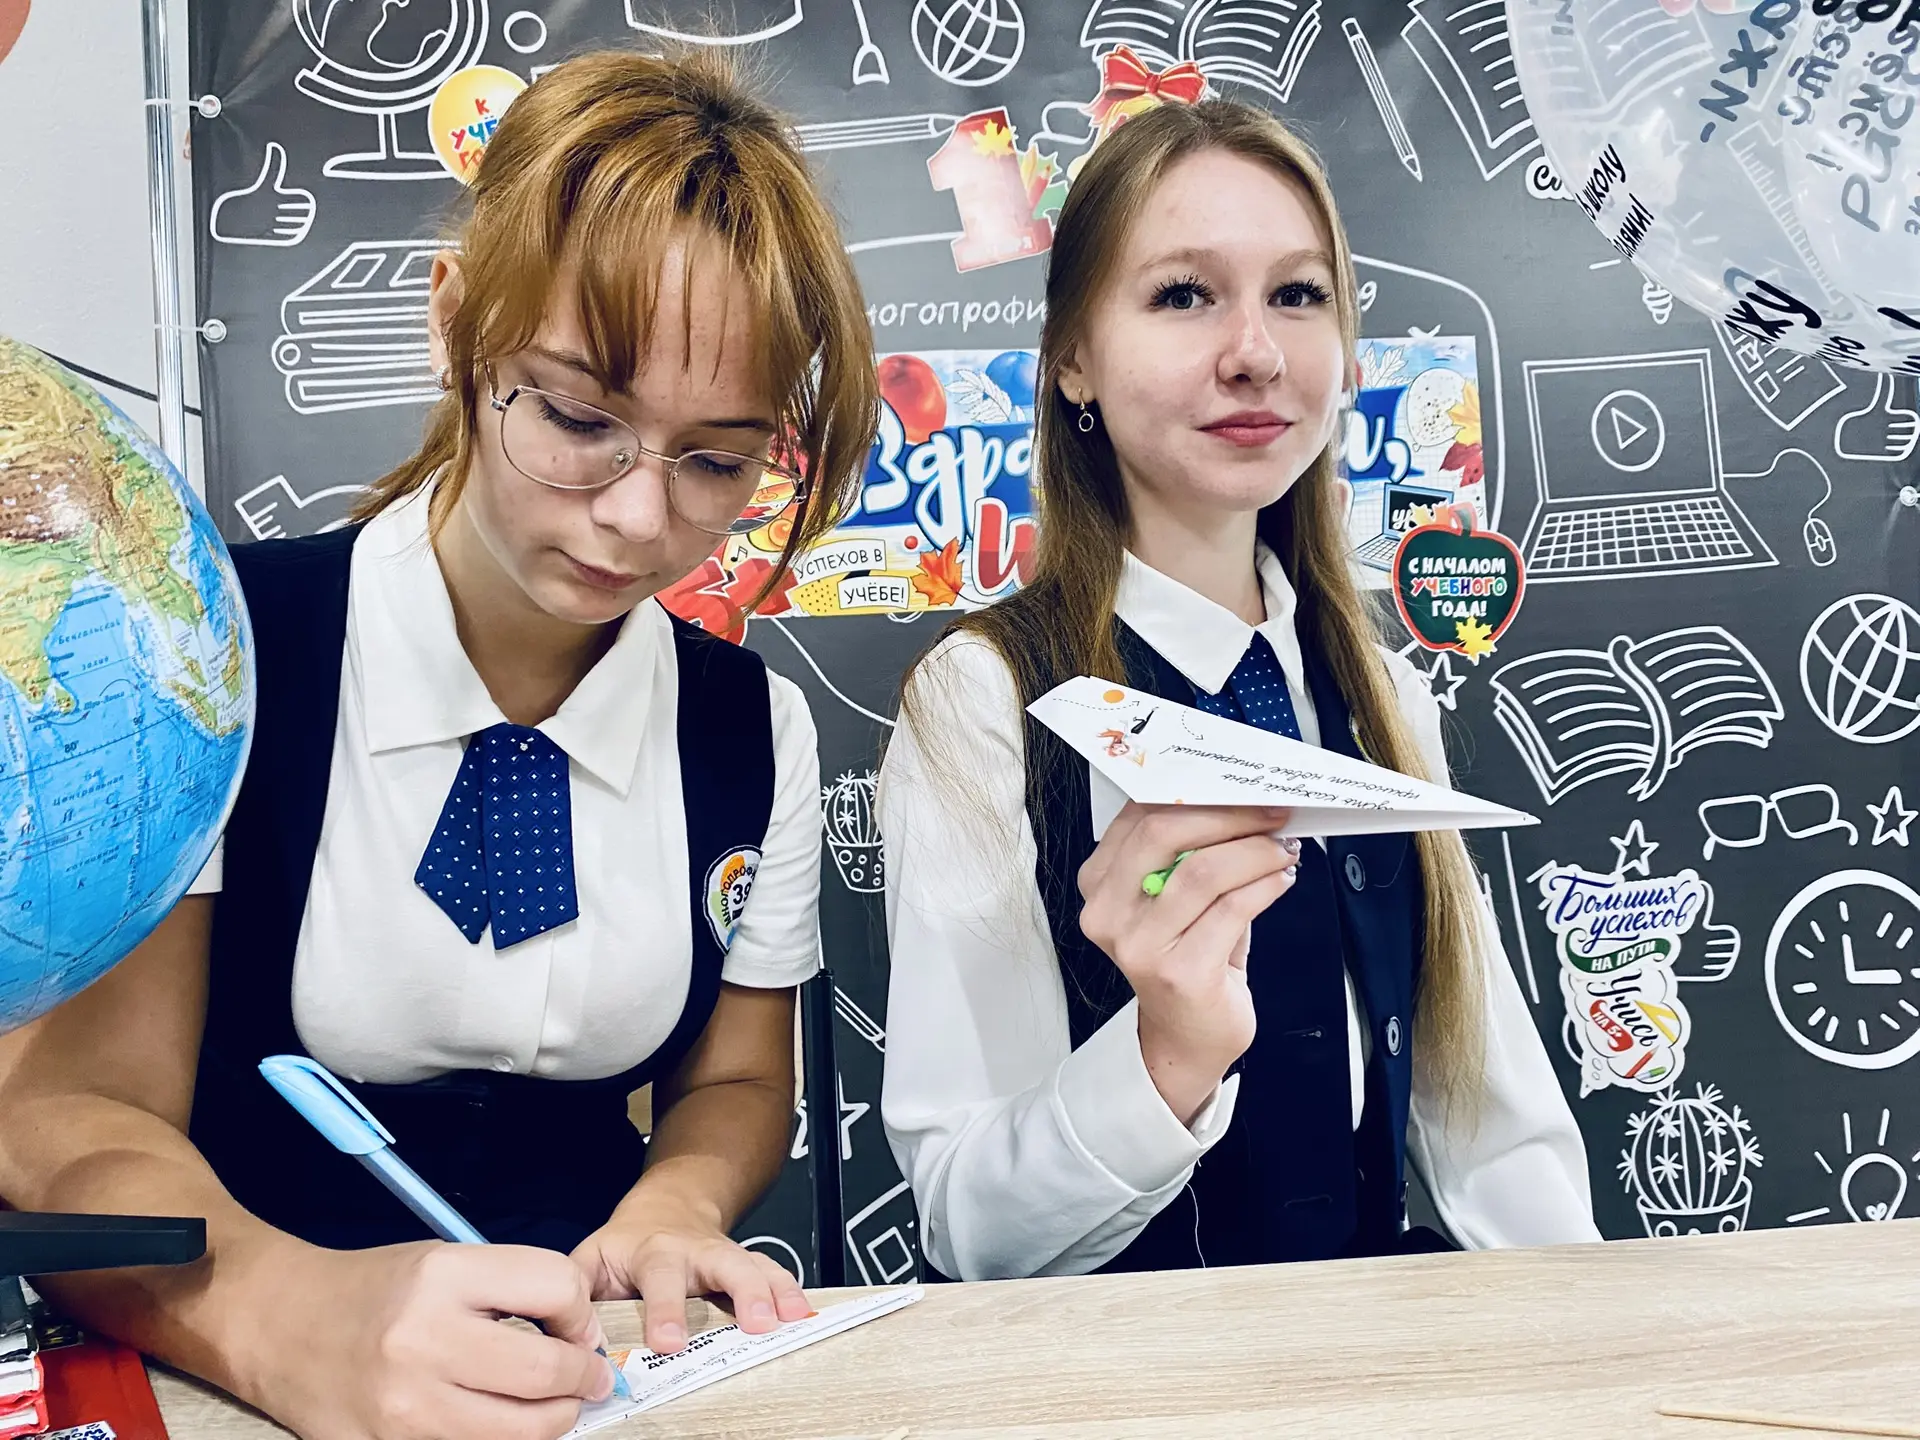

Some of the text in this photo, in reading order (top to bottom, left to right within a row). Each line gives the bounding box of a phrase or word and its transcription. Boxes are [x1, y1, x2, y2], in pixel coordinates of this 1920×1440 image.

[475, 98, 490, 116] К
[795, 548, 883, 579] УСПЕХОВ В
[1408, 557, 1507, 575] С НАЧАЛОМ
[844, 582, 905, 604] УЧЁБЕ!
[1411, 577, 1507, 597] УЧЕБНОГО
[1431, 600, 1487, 618] ГОДА!
[1159, 744, 1421, 800] приносит новые открытия!
[1221, 772, 1259, 787] день
[1264, 782, 1335, 801] каждый
[1550, 874, 1691, 924] Больших
[1583, 892, 1697, 954] успехов
[1591, 941, 1656, 971] НА ПУТИ
[1586, 968, 1658, 1046] Учись
[648, 1339, 714, 1370] ДЕТСТВА
